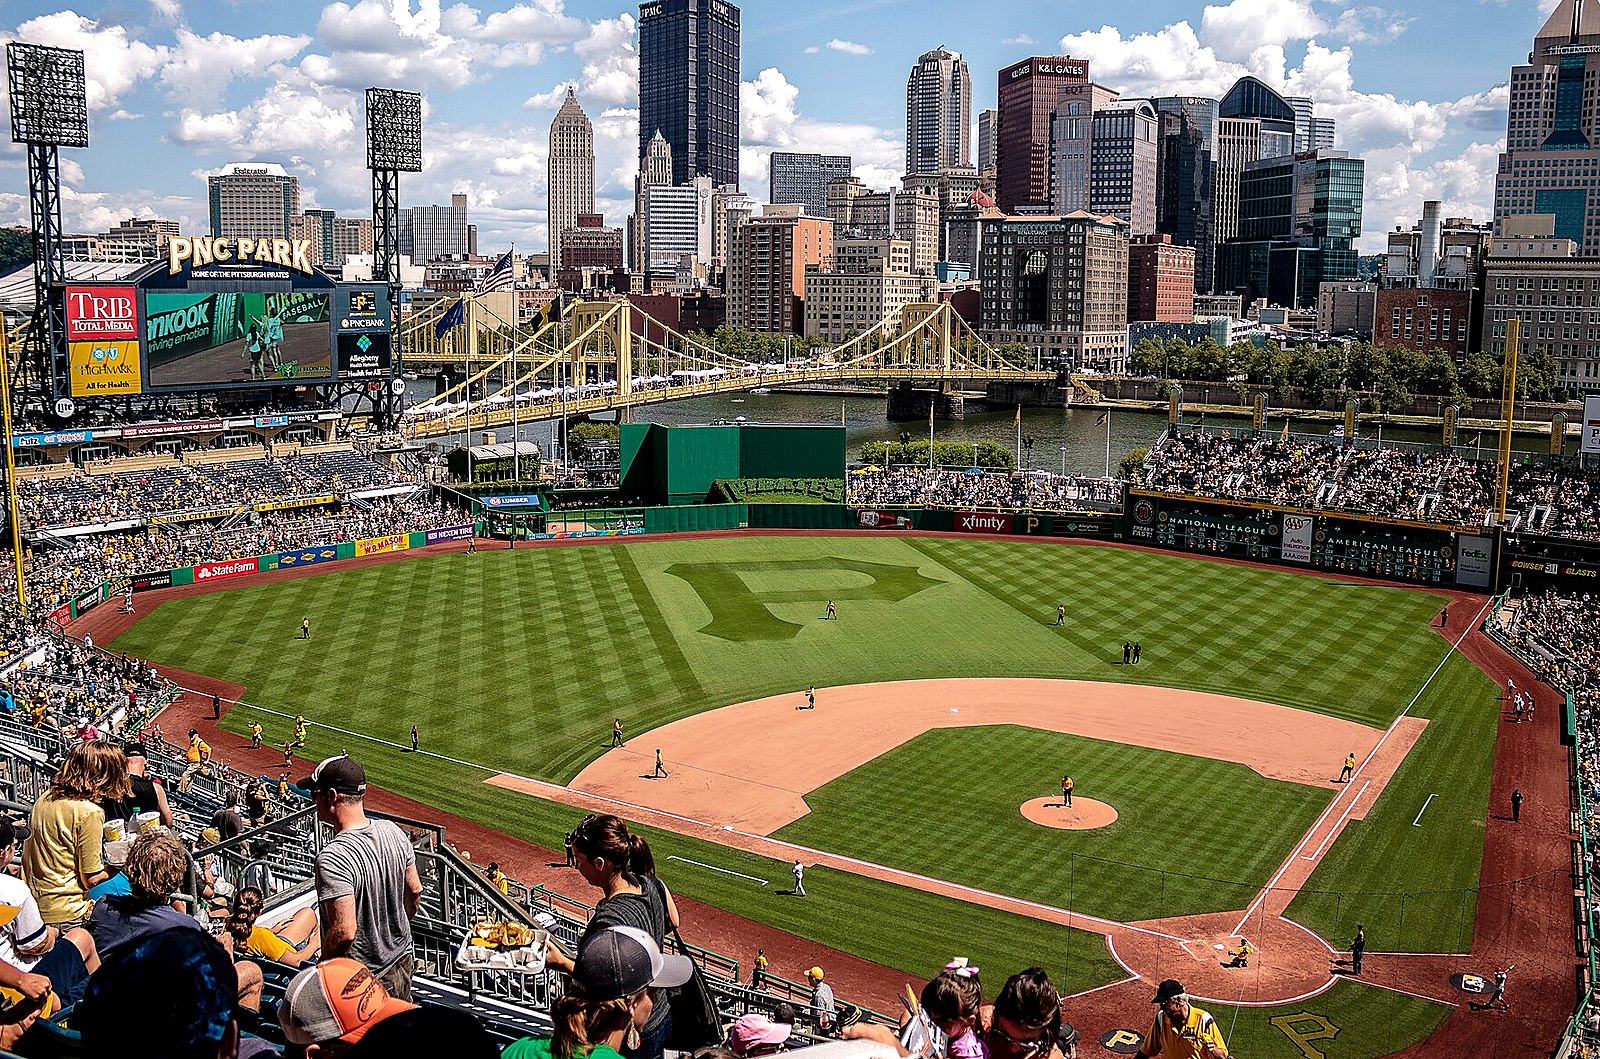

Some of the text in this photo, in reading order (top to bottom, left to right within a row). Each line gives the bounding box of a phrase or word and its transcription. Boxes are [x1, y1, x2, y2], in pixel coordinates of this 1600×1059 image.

[1039, 64, 1083, 74] K&L GATES
[168, 235, 314, 275] PNC PARK
[191, 270, 209, 278] HOME
[70, 292, 132, 318] TRIB
[174, 326, 210, 345] emotion
[80, 364, 133, 375] HIGHMARK
[86, 382, 96, 390] All
[58, 403, 72, 413] Lite
[962, 516, 1005, 530] xfinity
[1170, 518, 1266, 535] NATIONAL LEAGUE
[459, 526, 473, 534] TIRE
[1132, 530, 1153, 538] FAST!
[1284, 542, 1310, 550] Insurance
[1328, 538, 1438, 557] AMERICAN LEAGUE
[1461, 548, 1488, 559] FedEx
[1512, 560, 1544, 570] BOWSER
[1566, 567, 1597, 578] BLASTS
[150, 578, 170, 586] SPORTS
